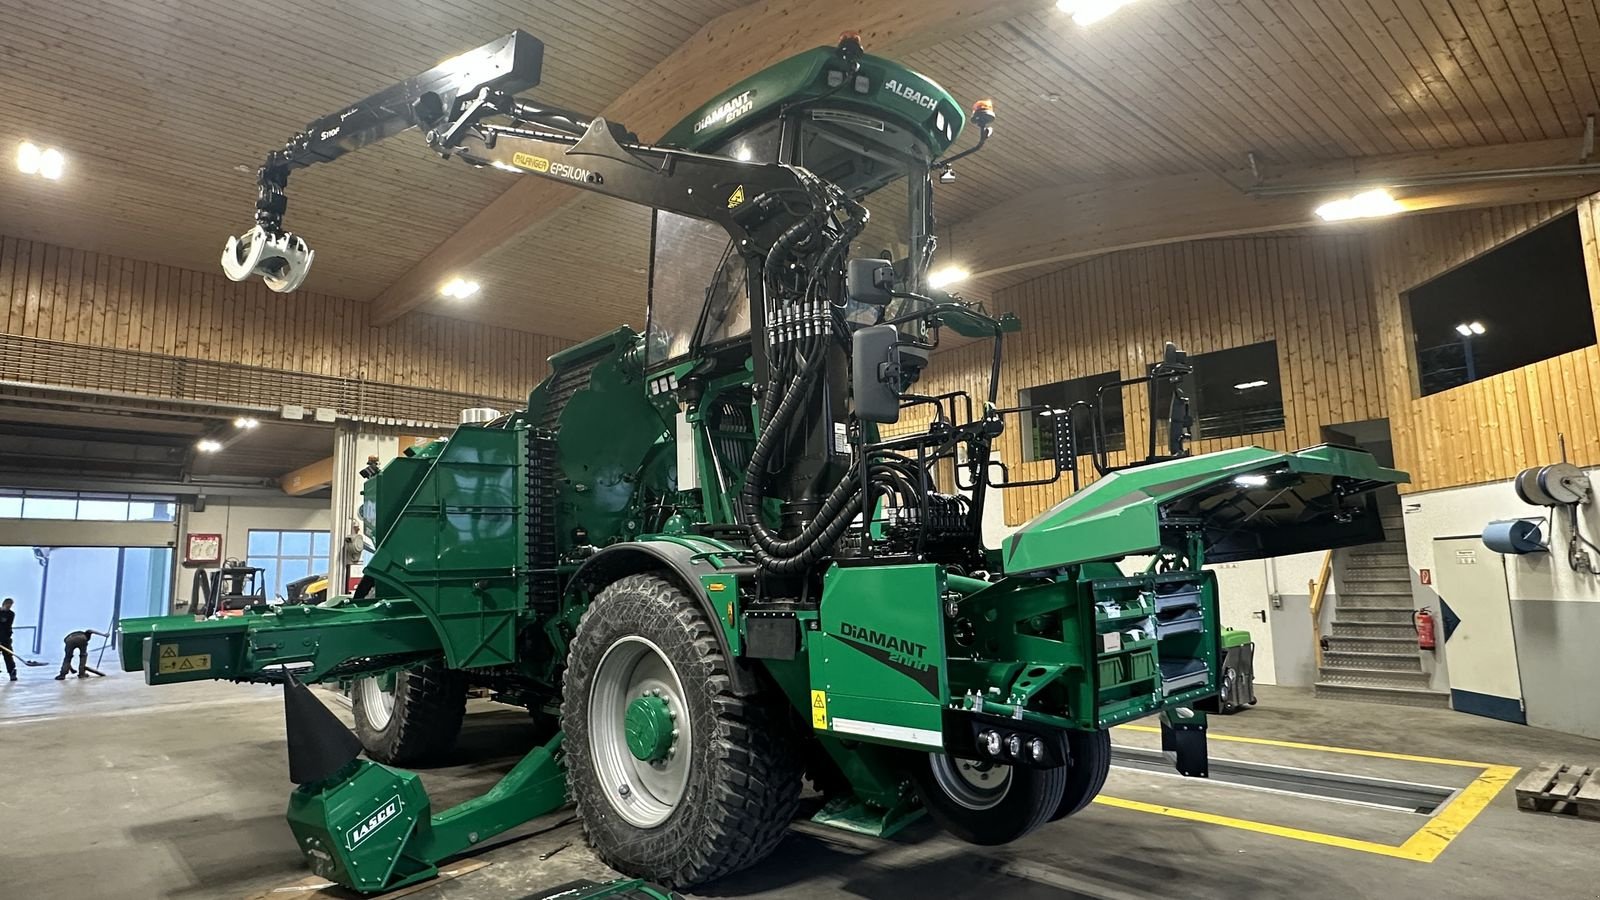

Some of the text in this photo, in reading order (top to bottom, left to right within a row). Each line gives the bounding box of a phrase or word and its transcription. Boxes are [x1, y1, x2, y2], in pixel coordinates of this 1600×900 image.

[885, 79, 938, 111] ALBACH
[550, 162, 590, 183] EPSILON
[353, 802, 396, 843] LASCO
